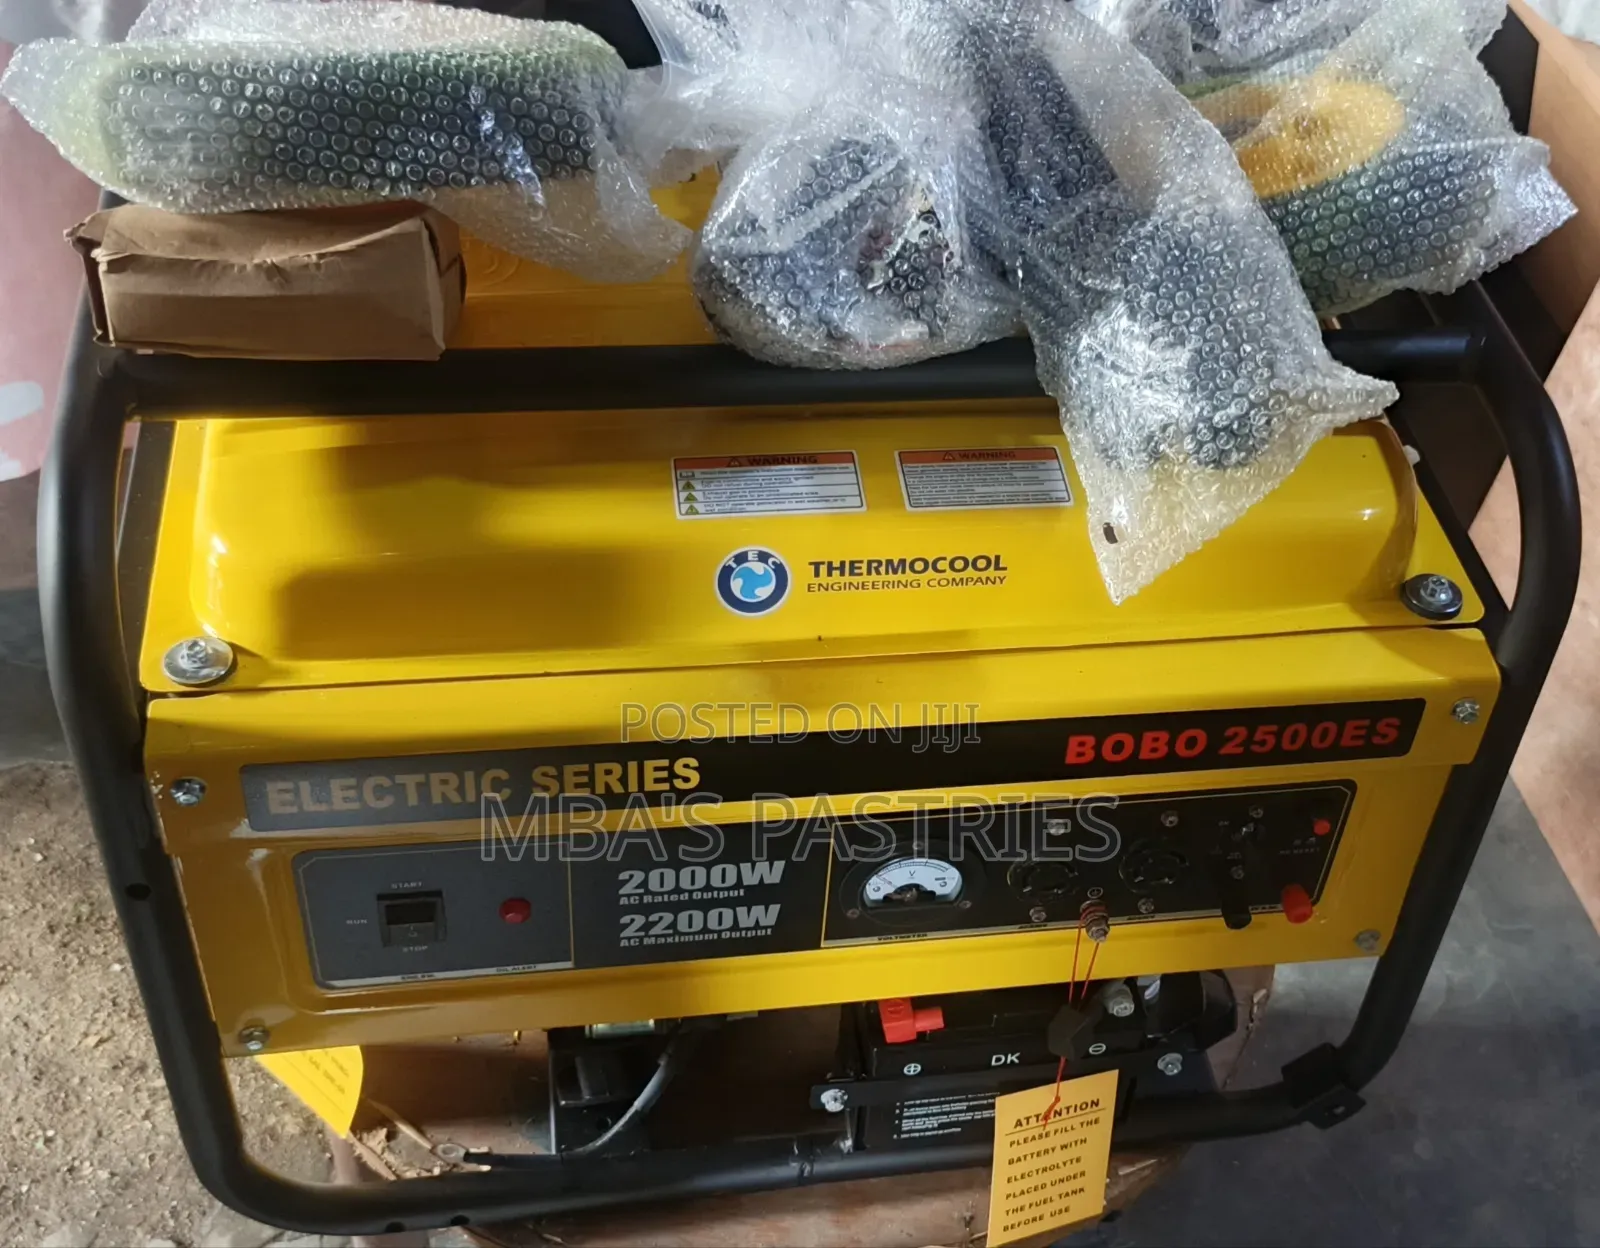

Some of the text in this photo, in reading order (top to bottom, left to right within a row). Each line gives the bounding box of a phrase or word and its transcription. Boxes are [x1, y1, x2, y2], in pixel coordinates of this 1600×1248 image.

[747, 455, 818, 466] WARNING
[958, 451, 1017, 461] WARNING
[724, 550, 782, 571] TEC
[808, 554, 1008, 579] THERMOCOOL
[807, 575, 1007, 593] ENGINEERING COMPANY
[1065, 717, 1400, 764] BOBO 2500ES
[266, 756, 701, 815] ELECTRIC SERIES
[618, 860, 786, 895] 2000W
[619, 888, 745, 906] AC Rated Output
[619, 903, 782, 938] 2200W
[620, 927, 773, 947] AC Maximum Output
[991, 1052, 1021, 1067] DK
[1009, 1117, 1101, 1148] PLEASE FILL THE
[1007, 1137, 1088, 1165] BATTERY WITH
[1006, 1156, 1082, 1184] ELECTROLYTE
[1005, 1170, 1086, 1200] PLACED UNDER
[1005, 1186, 1085, 1217] THE FUEL TANK
[1003, 1206, 1071, 1232] BEFORE USE
